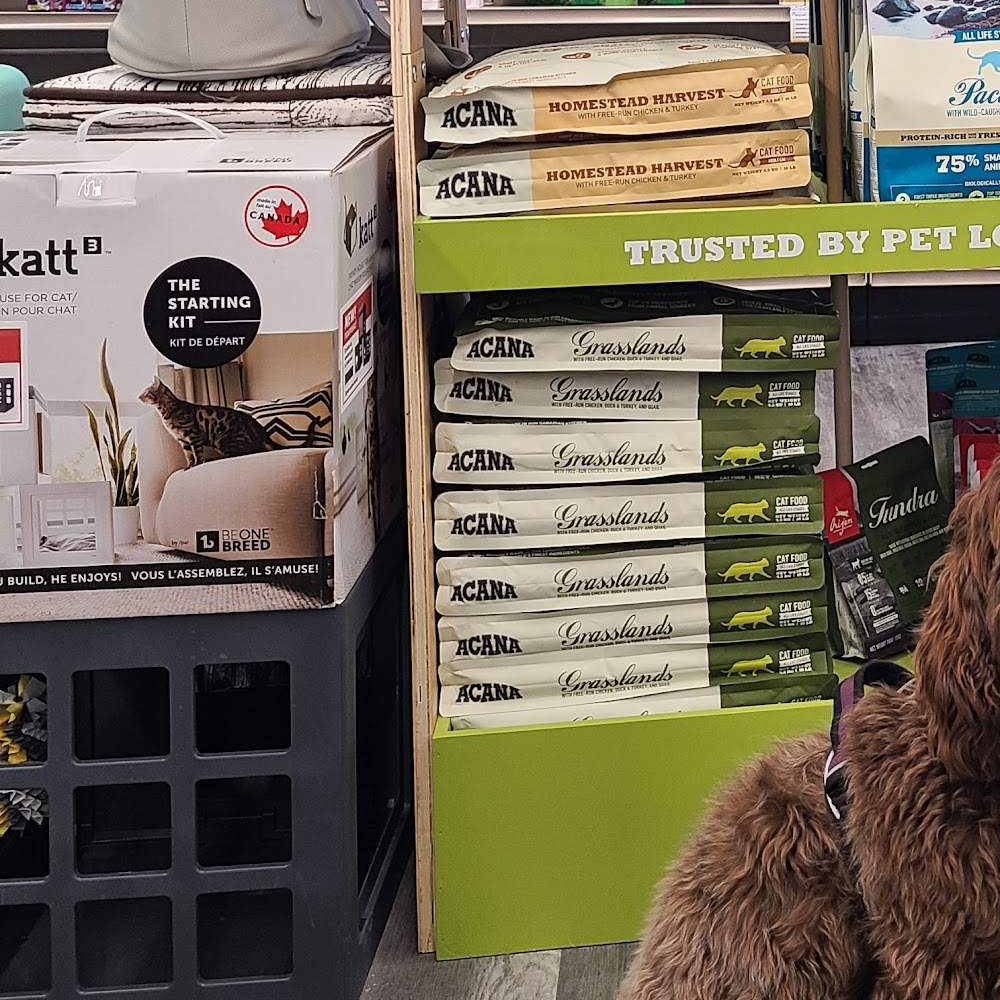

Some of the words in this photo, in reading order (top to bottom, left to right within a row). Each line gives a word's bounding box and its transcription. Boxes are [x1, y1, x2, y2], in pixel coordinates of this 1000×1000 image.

[962, 31, 974, 40] ALL
[976, 31, 992, 40] LIFE
[548, 95, 649, 113] HOMESTEAD
[652, 88, 726, 105] HARVEST
[440, 100, 518, 128] ACANA
[946, 109, 961, 117] WITH
[900, 133, 967, 142] PROTEIN-RICH
[935, 153, 980, 173] 75%
[249, 210, 301, 226] CANADA
[624, 234, 805, 266] TRUSTED
[817, 230, 870, 256] BY
[882, 226, 957, 253] PET
[168, 279, 200, 291] THE
[24, 294, 49, 302] FOR
[51, 292, 77, 302] CAT/
[168, 296, 251, 310] STARTING
[12, 306, 45, 315] POUR
[47, 305, 77, 315] CHAT
[168, 315, 197, 329] KIT
[169, 338, 185, 348] KIT
[188, 337, 203, 347] DE
[205, 334, 246, 347] DÉPART
[466, 336, 534, 359] ACANA
[571, 331, 687, 357] Grasslands
[449, 376, 513, 403] ACANA
[549, 376, 663, 403] Grasslands
[868, 486, 939, 529] Tundra
[222, 540, 271, 552] BREED
[7, 575, 47, 587] BUILD,
[51, 574, 67, 585] HE
[70, 571, 122, 584] ENJOYS!
[131, 570, 164, 581] VOUS
[251, 566, 262, 577] IL
[450, 579, 518, 601] ACANA
[554, 563, 669, 593] Grasslands
